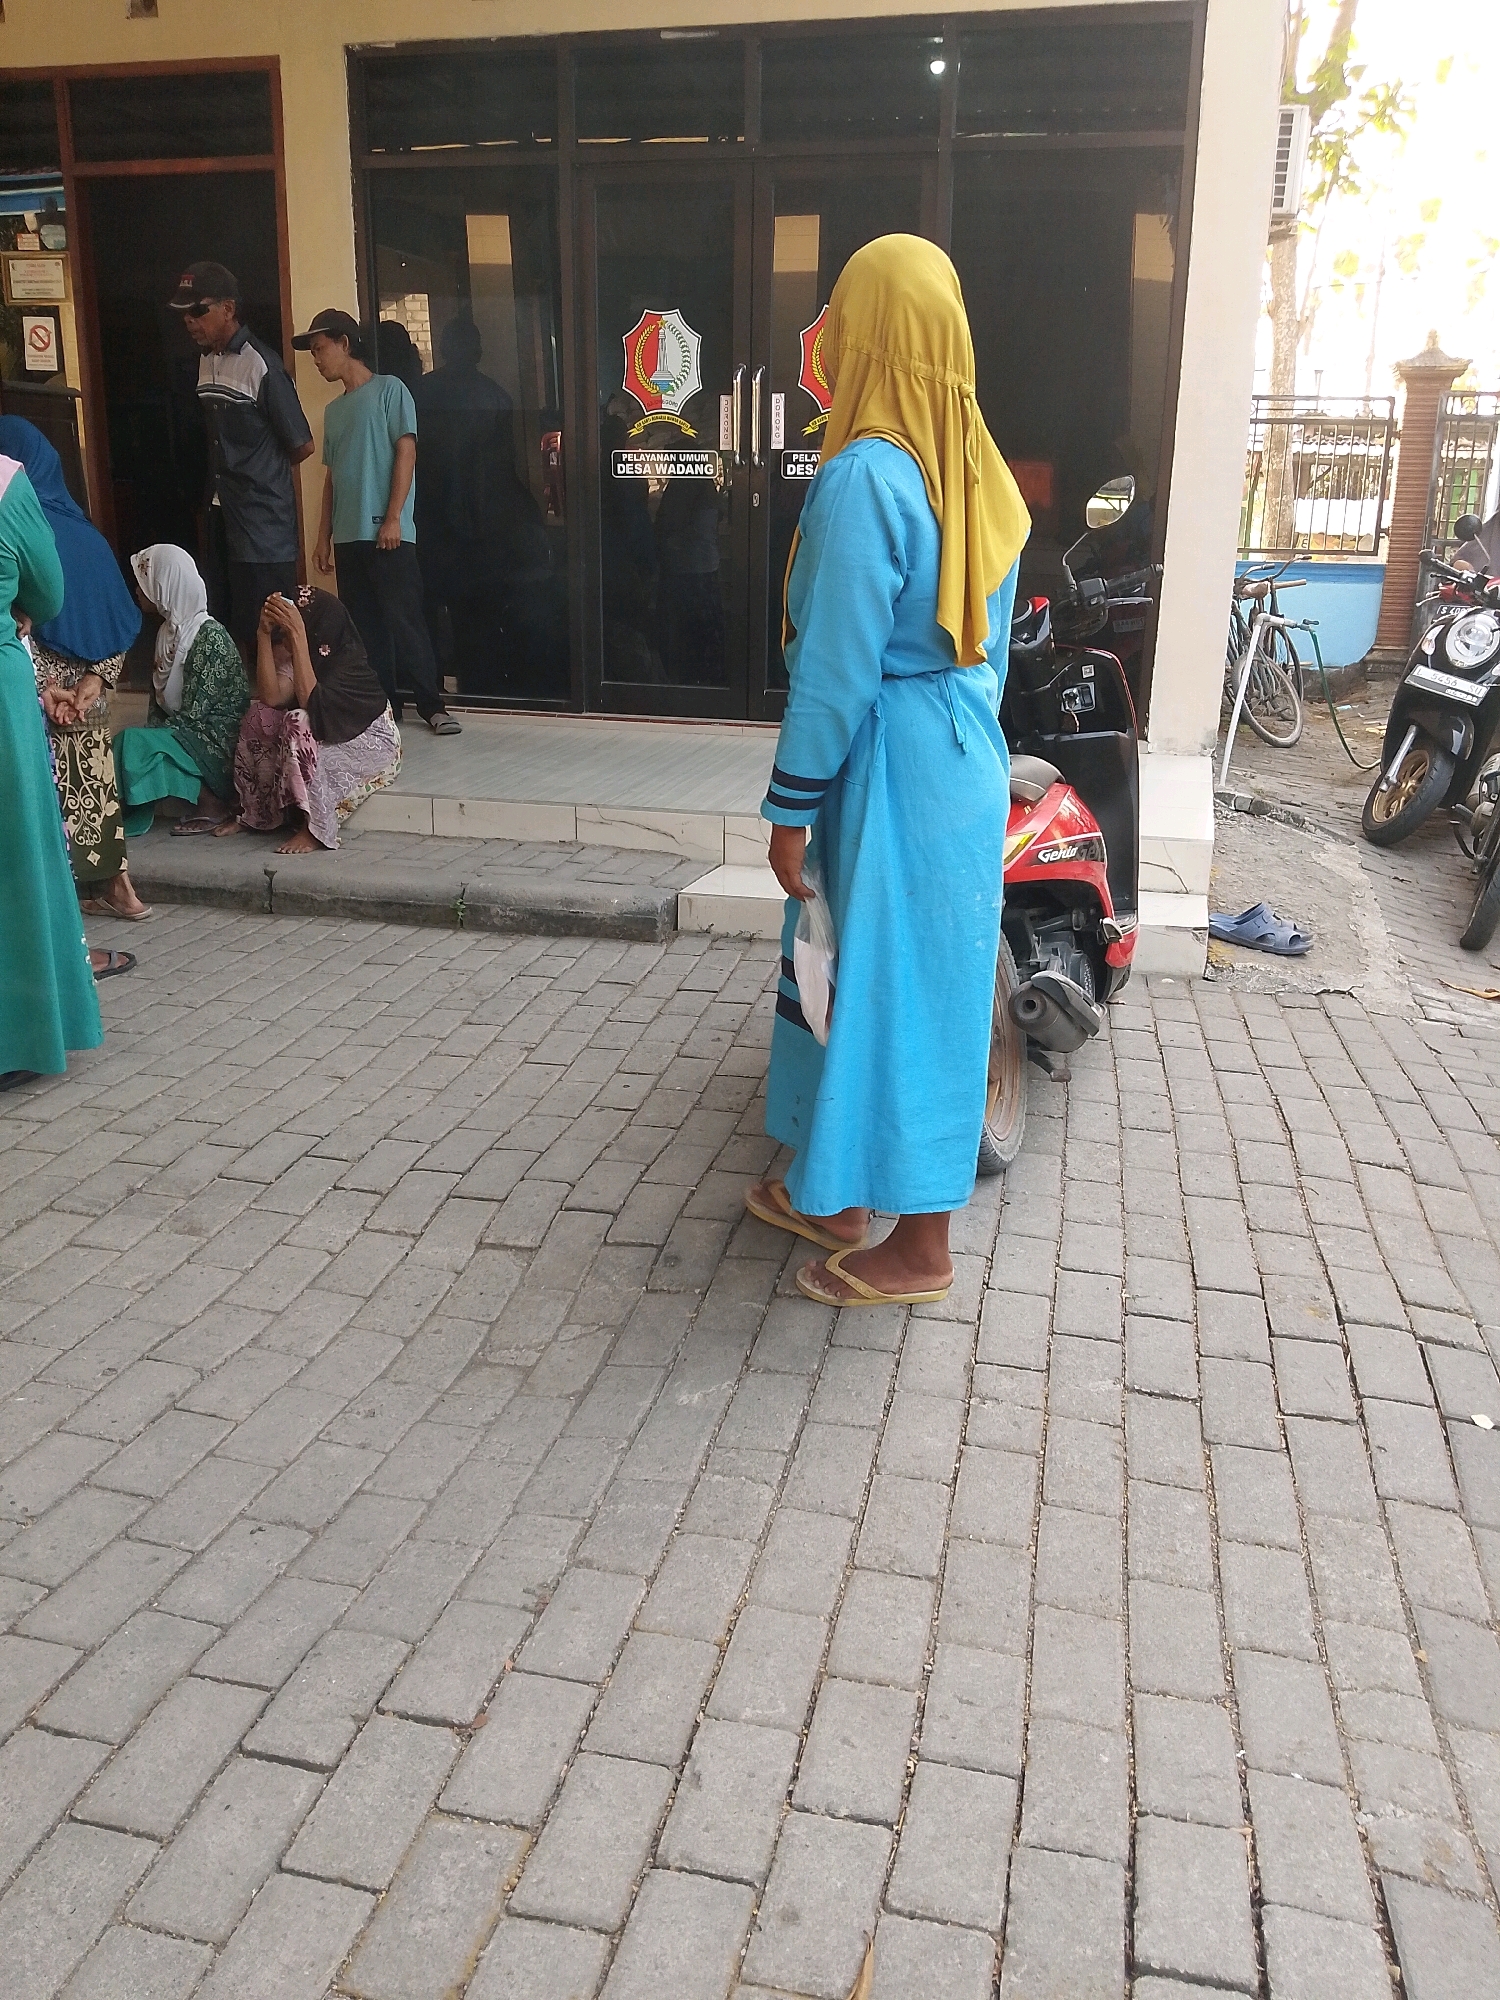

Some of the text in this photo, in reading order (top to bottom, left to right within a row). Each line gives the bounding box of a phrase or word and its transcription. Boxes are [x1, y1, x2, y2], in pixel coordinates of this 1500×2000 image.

[622, 453, 709, 462] PELAYANAN UMUM
[617, 463, 714, 475] DESA WADANG
[1037, 846, 1079, 863] Genio
